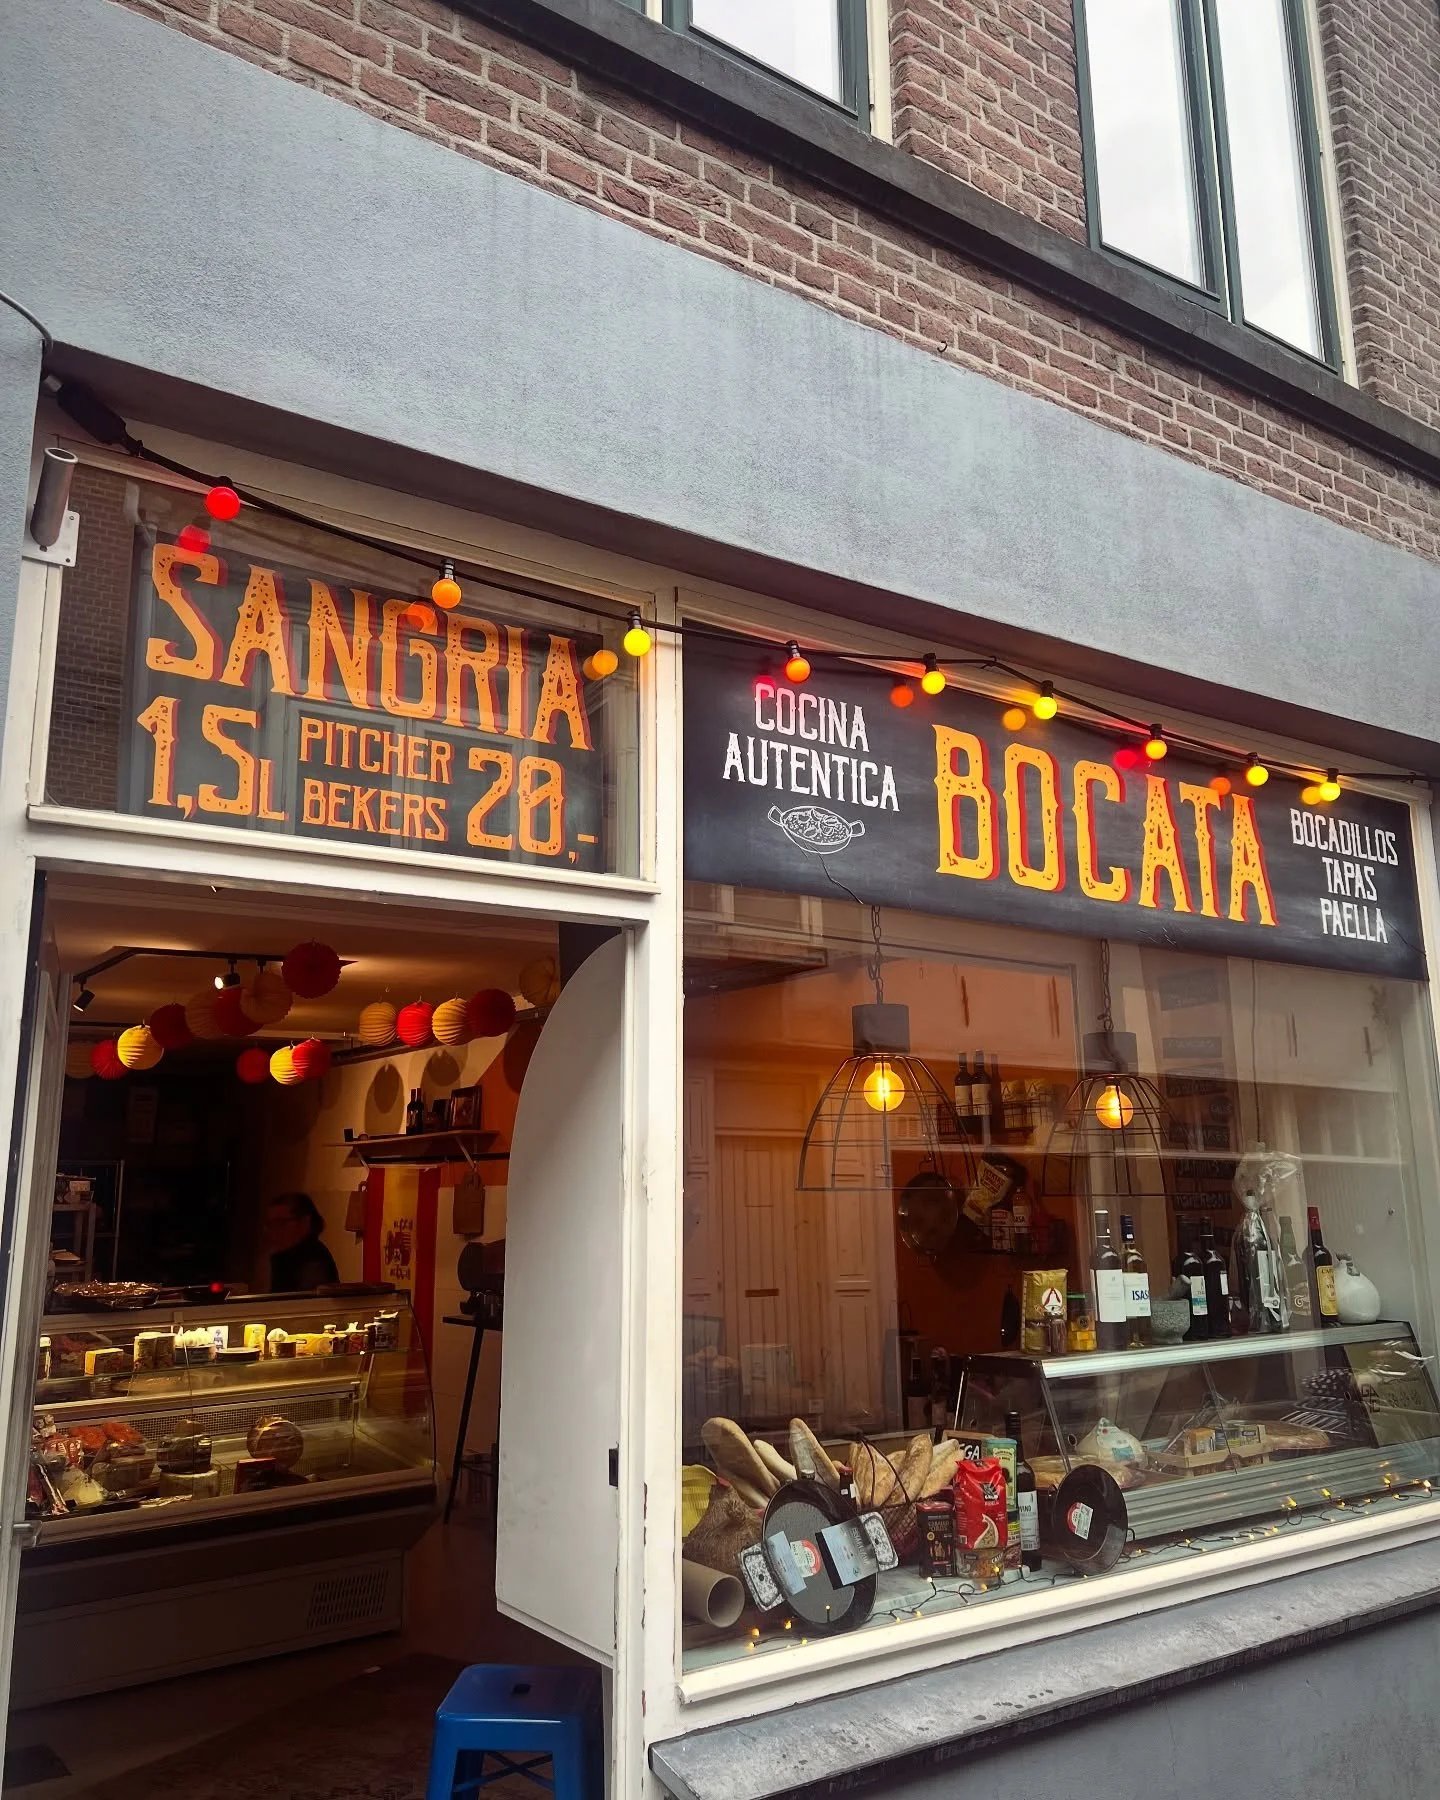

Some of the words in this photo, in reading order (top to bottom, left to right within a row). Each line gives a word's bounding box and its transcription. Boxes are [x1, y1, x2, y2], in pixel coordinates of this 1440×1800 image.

[147, 544, 592, 750] SANGRIA
[299, 717, 453, 784] PITCHER
[754, 682, 870, 752] COCINA
[724, 732, 900, 812] AUTENTICA
[302, 777, 447, 842] BEKERS
[933, 724, 1277, 926] BOCATA
[1290, 809, 1399, 866] BOCADILLOS
[1322, 858, 1377, 901] TAPAS
[1320, 900, 1389, 944] PAELLA
